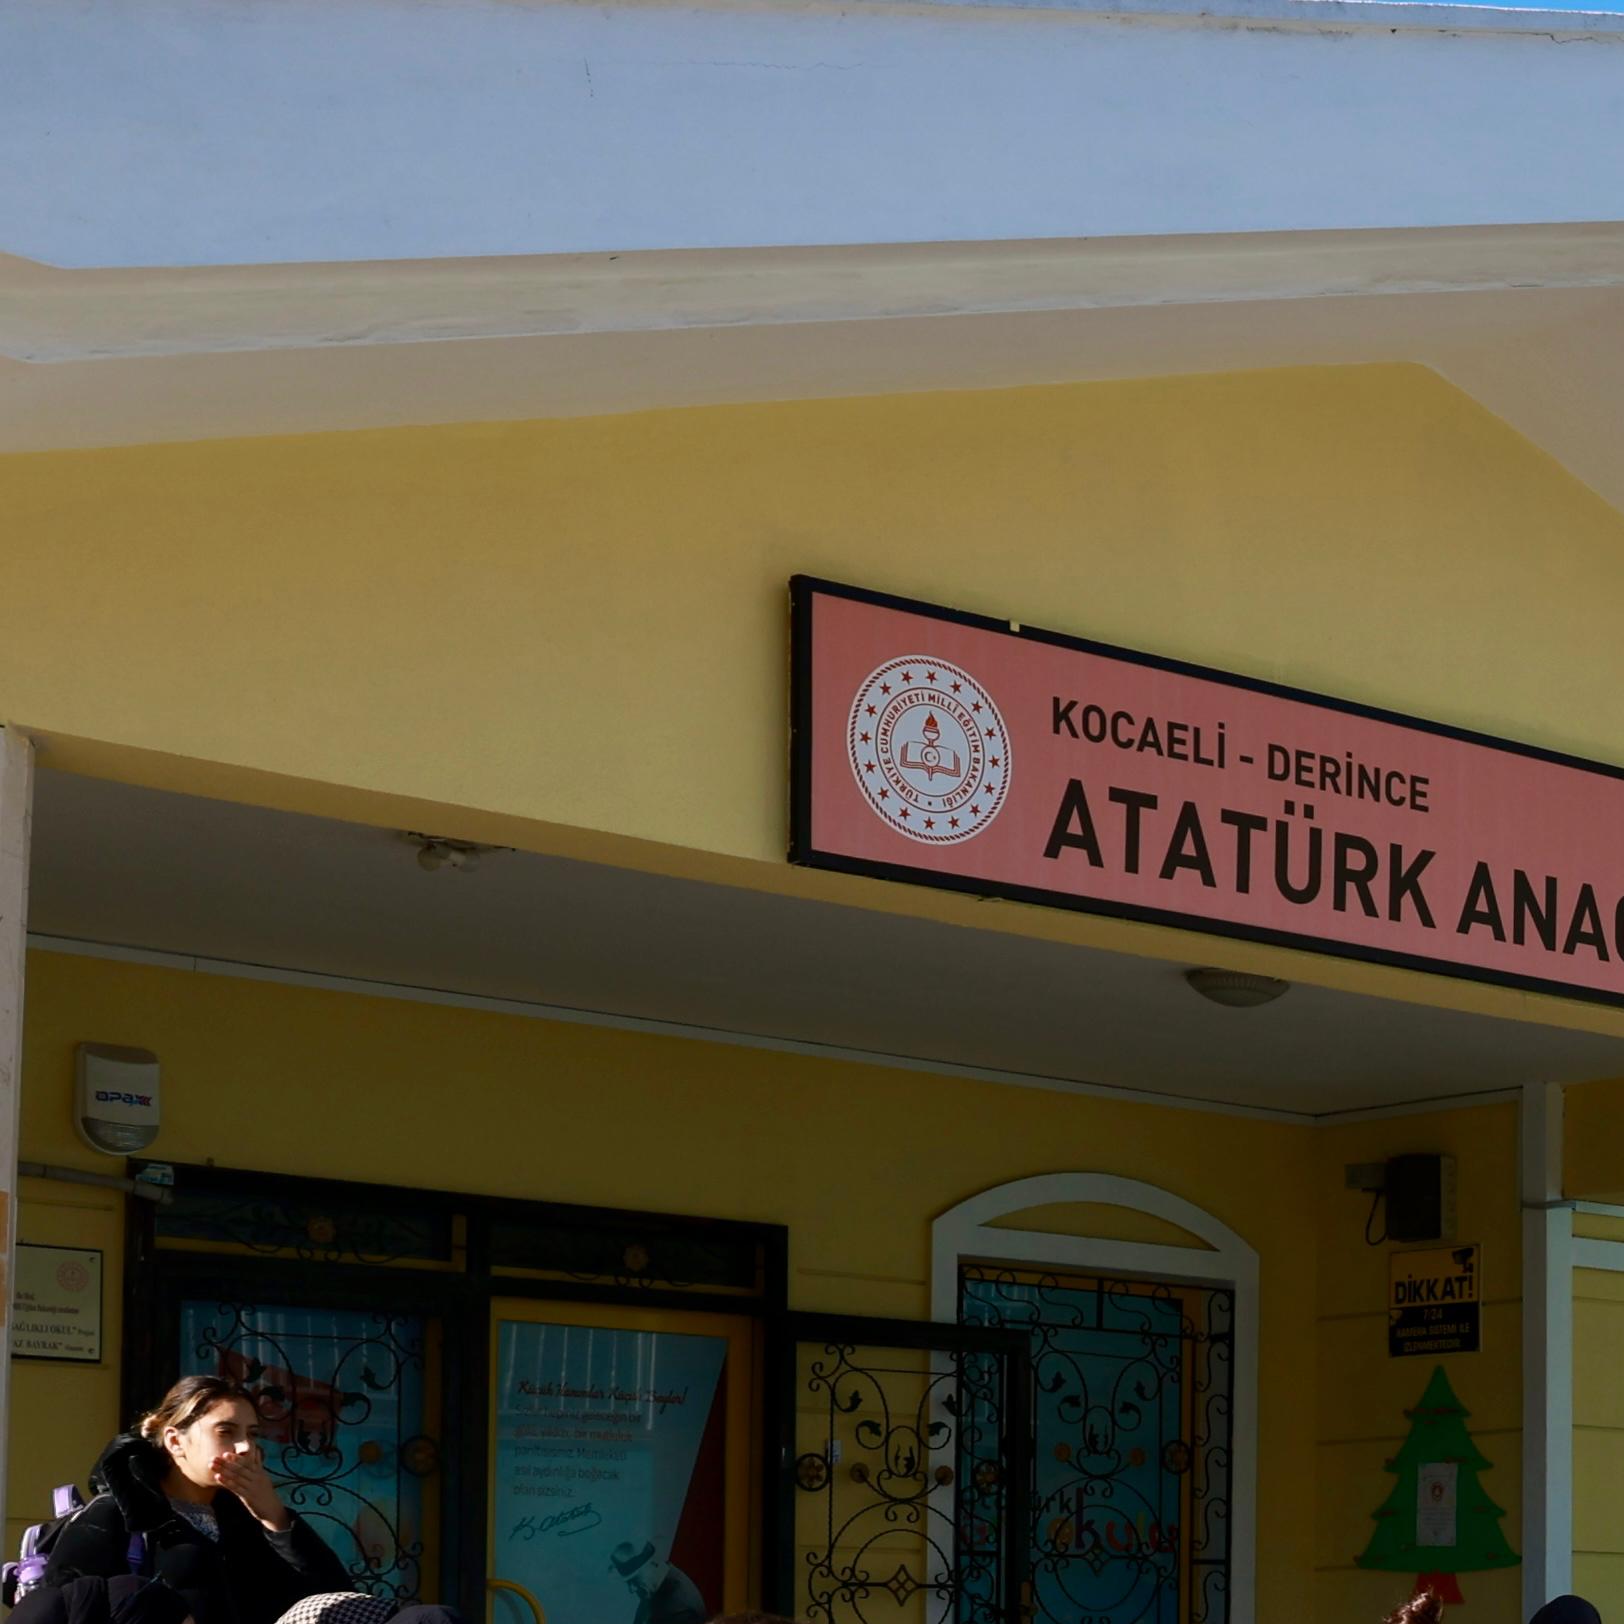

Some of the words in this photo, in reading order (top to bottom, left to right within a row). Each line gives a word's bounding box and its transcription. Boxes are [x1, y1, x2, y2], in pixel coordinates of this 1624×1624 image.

[879, 691, 926, 754] CUMHURİYETİ
[1052, 696, 1226, 769] KOCAELİ
[1267, 743, 1430, 813] DERİNCE
[1043, 777, 1437, 929] ATATÜRK
[1394, 1273, 1473, 1304] DİKKAT!
